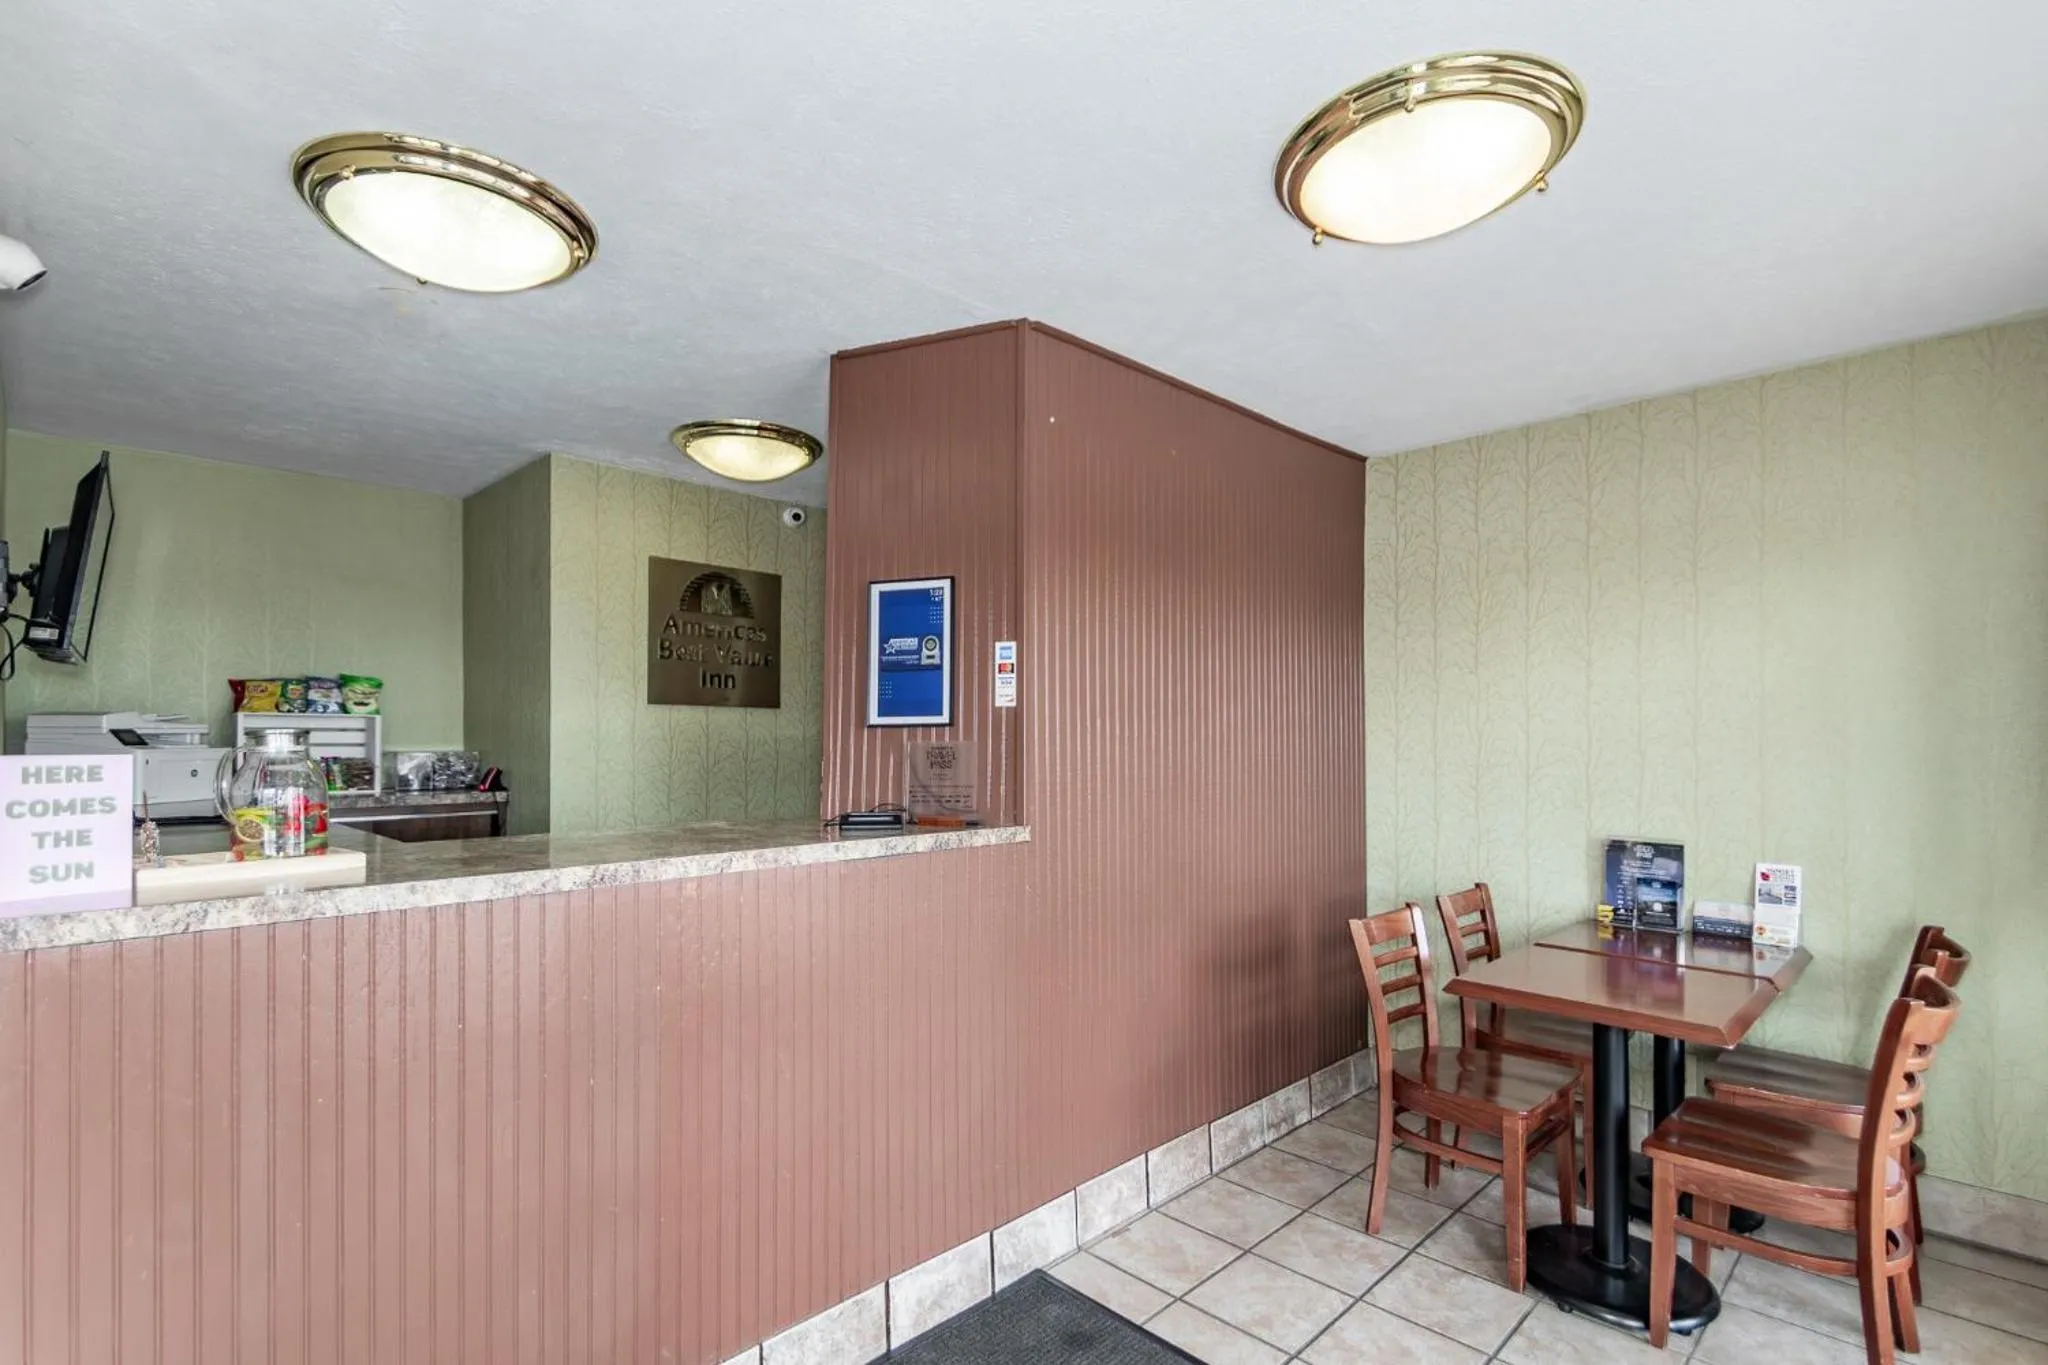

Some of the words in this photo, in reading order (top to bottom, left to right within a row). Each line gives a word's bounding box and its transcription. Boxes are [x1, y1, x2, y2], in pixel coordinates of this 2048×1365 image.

[700, 667, 736, 689] Inn
[21, 765, 104, 785] HERE
[5, 796, 118, 819] COMES
[31, 829, 94, 850] THE
[28, 861, 95, 885] SUN
